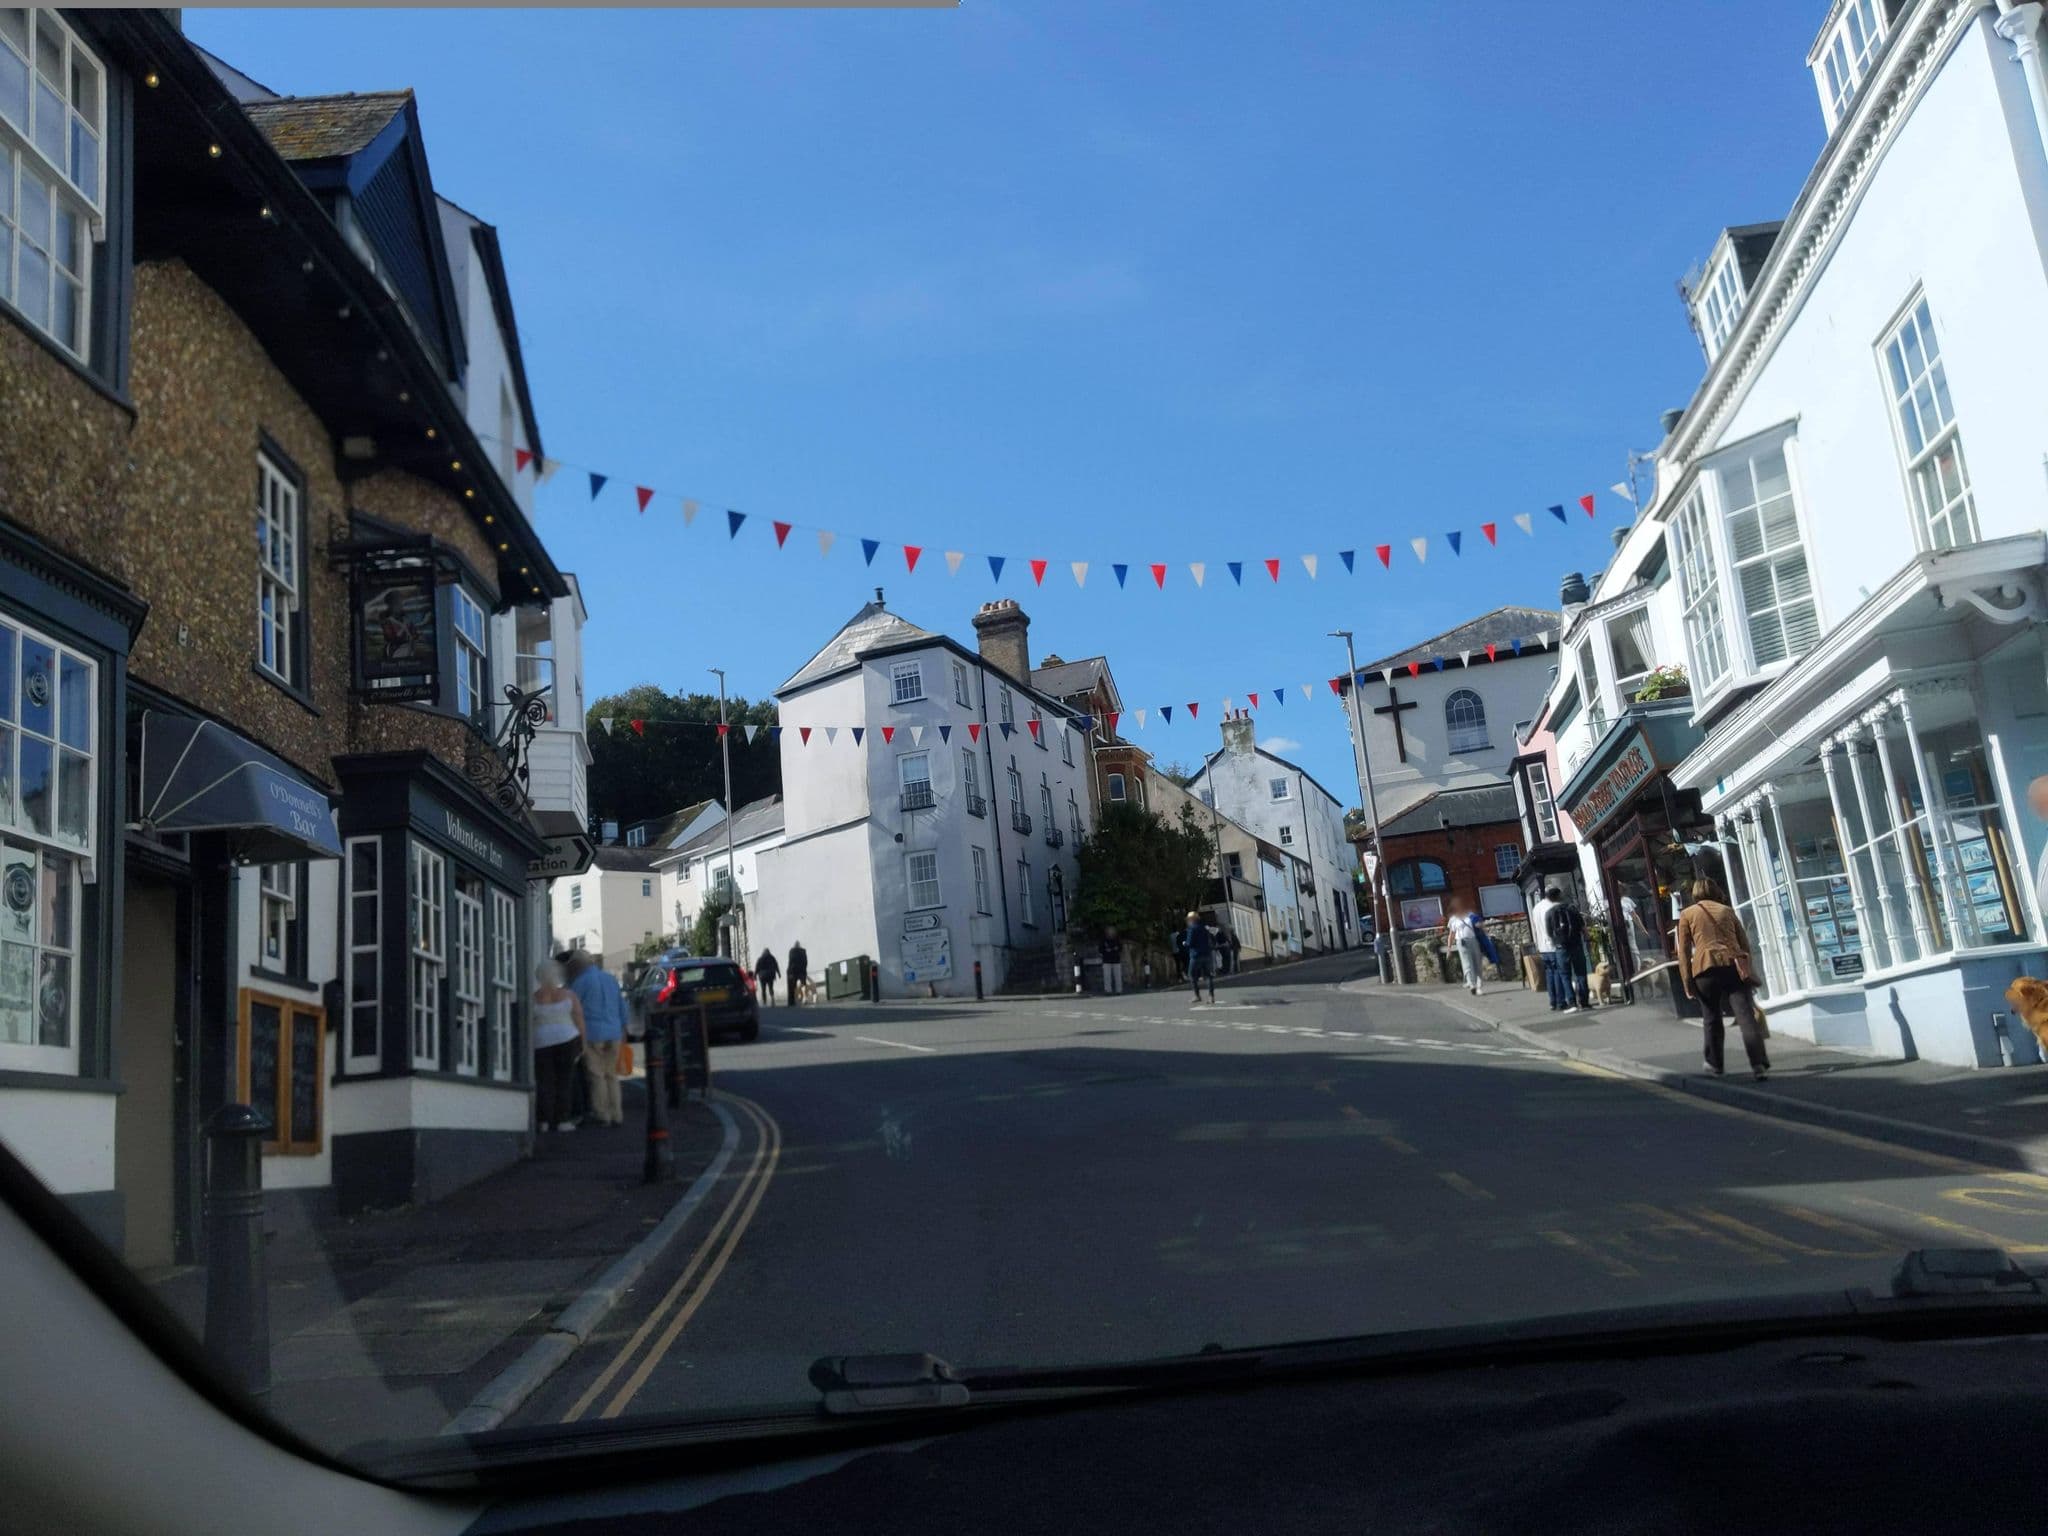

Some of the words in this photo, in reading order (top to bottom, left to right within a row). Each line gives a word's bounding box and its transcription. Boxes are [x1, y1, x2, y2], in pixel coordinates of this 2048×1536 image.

[290, 810, 316, 838] Bar
[446, 811, 487, 858] Volunteer
[490, 841, 503, 868] Inn
